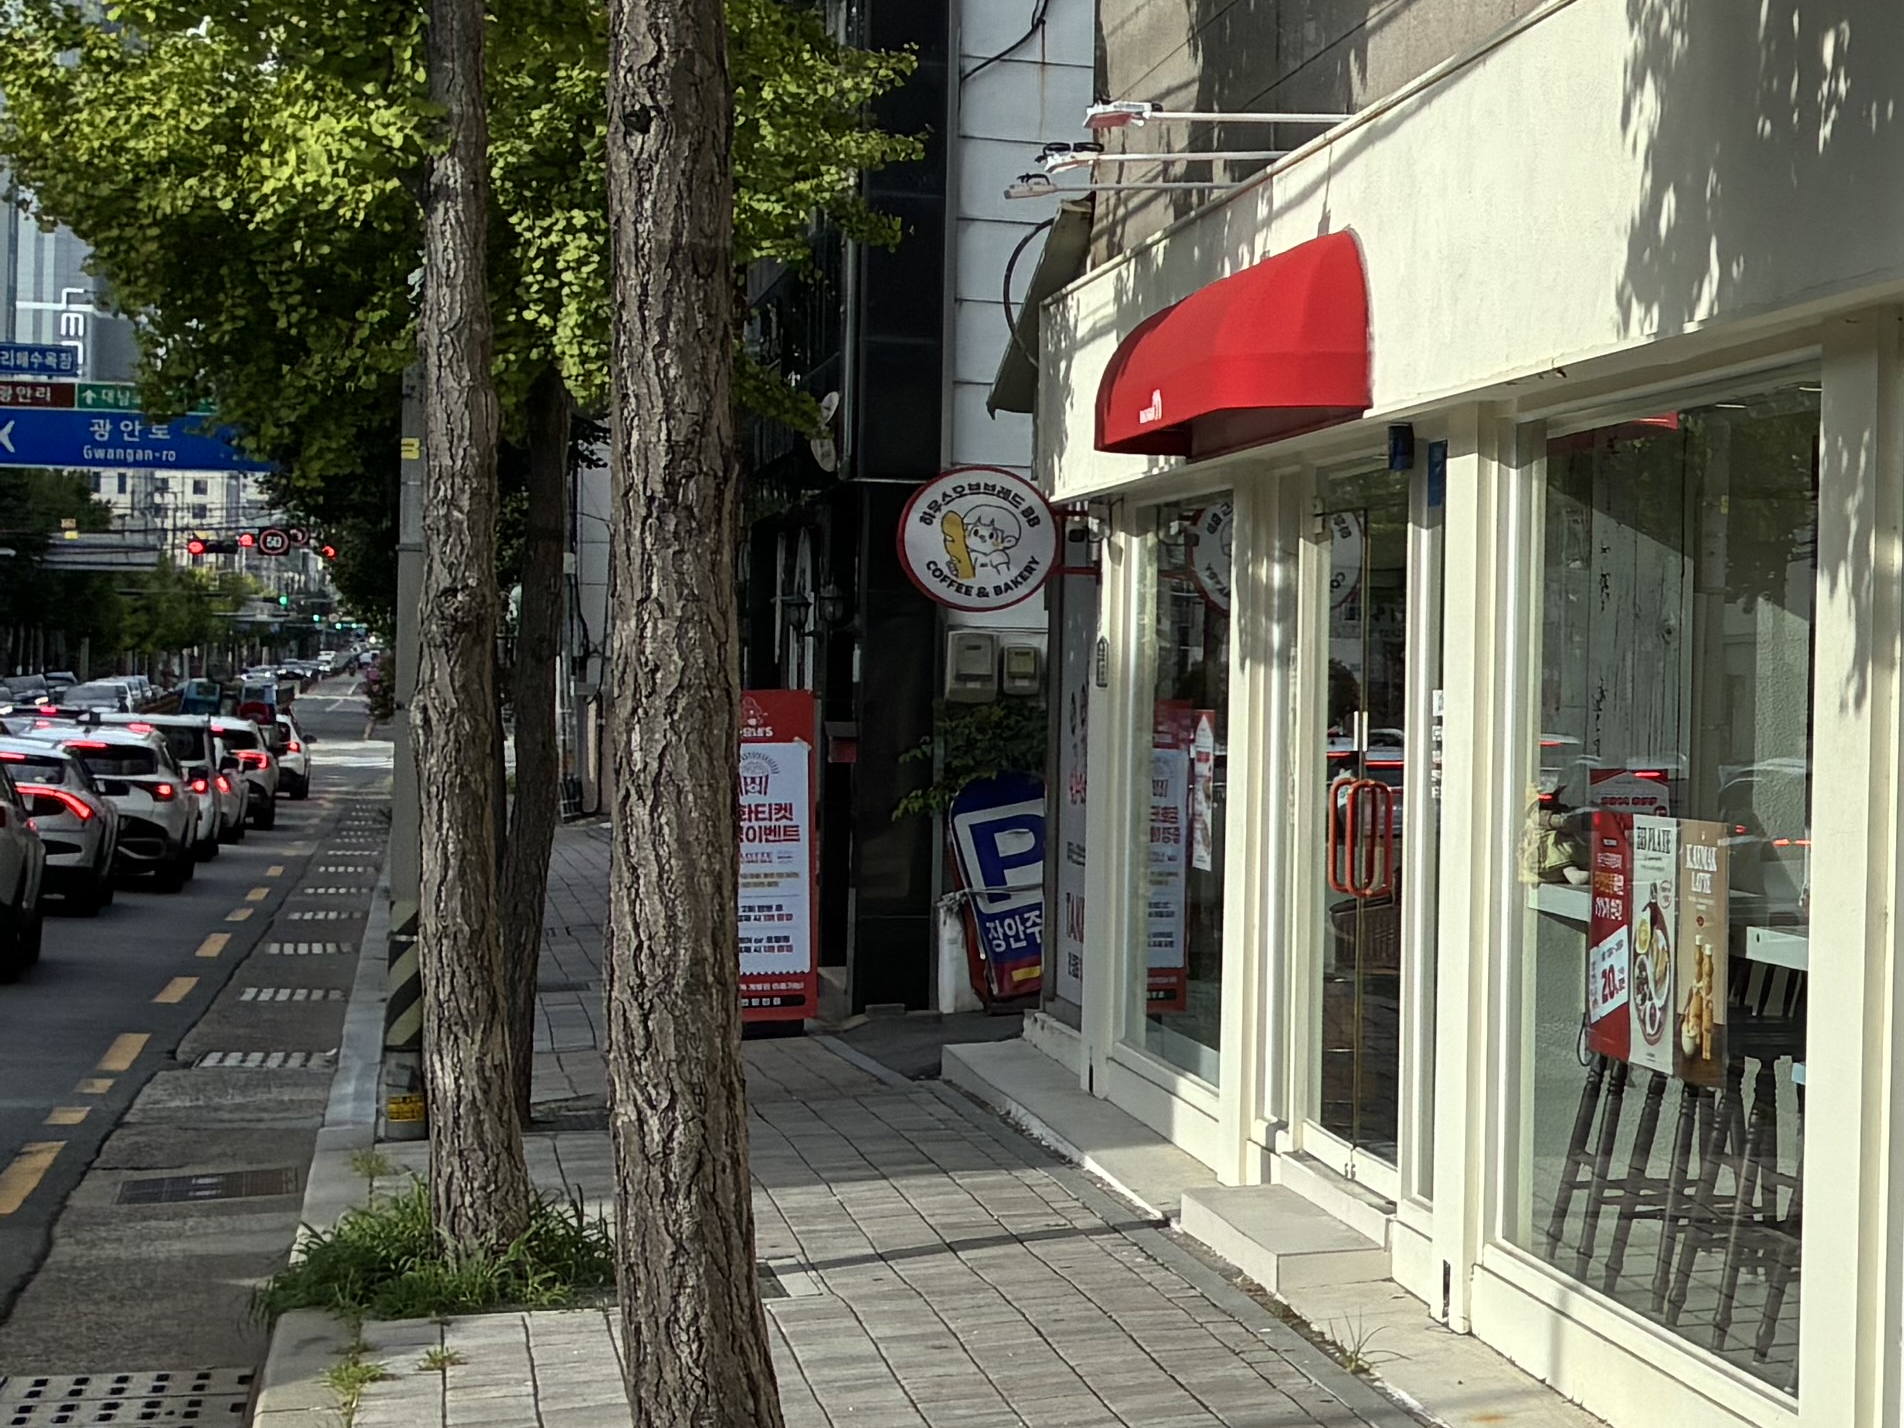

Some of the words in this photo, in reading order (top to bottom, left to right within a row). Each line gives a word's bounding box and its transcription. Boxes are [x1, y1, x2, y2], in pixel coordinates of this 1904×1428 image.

[83, 445, 177, 462] Gwangan-ro
[919, 481, 1026, 526] 하우스오브브레드
[1020, 505, 1041, 528] BB
[926, 560, 974, 597] COFFEE
[976, 586, 990, 599] &
[992, 555, 1041, 597] BAKERY
[740, 824, 801, 844] 이벤트
